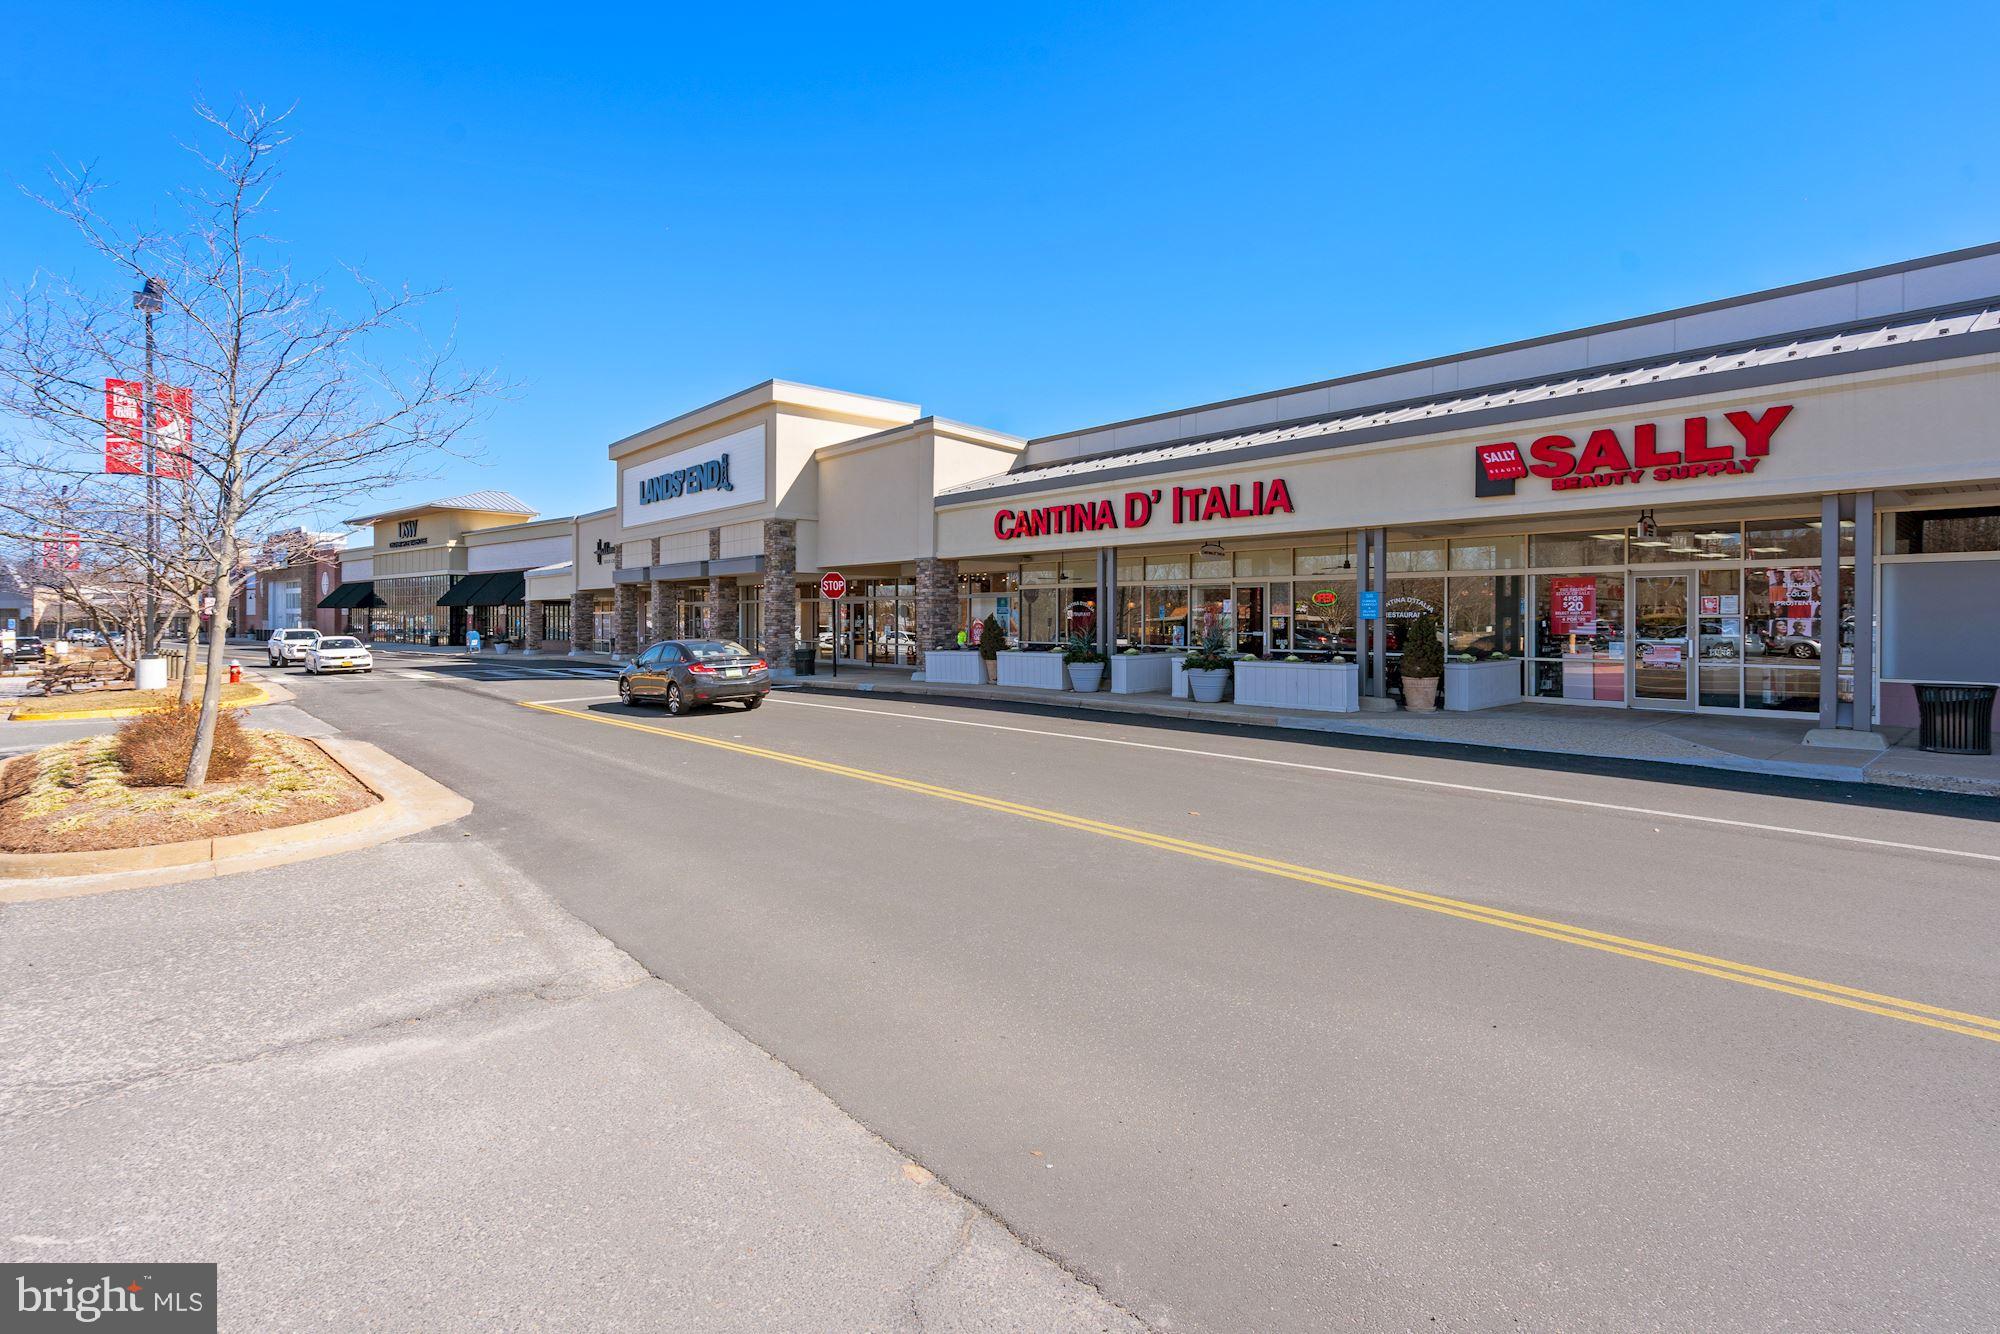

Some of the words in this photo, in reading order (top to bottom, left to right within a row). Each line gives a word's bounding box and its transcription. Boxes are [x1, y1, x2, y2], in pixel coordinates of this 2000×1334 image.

[1530, 405, 1794, 479] SALLY
[1483, 450, 1516, 464] SALLY
[1489, 466, 1522, 474] BEAUTY
[1552, 469, 1645, 491] BEAUTY
[1653, 458, 1761, 482] SUPPLY
[640, 469, 686, 505] LANDS'
[686, 460, 721, 494] END
[993, 500, 1118, 540] CANTINA
[1125, 489, 1162, 528] D'
[1172, 478, 1295, 524] ITALIA
[823, 580, 844, 591] STOP
[1386, 596, 1405, 607] NTINA
[1562, 601, 1584, 612] $20
